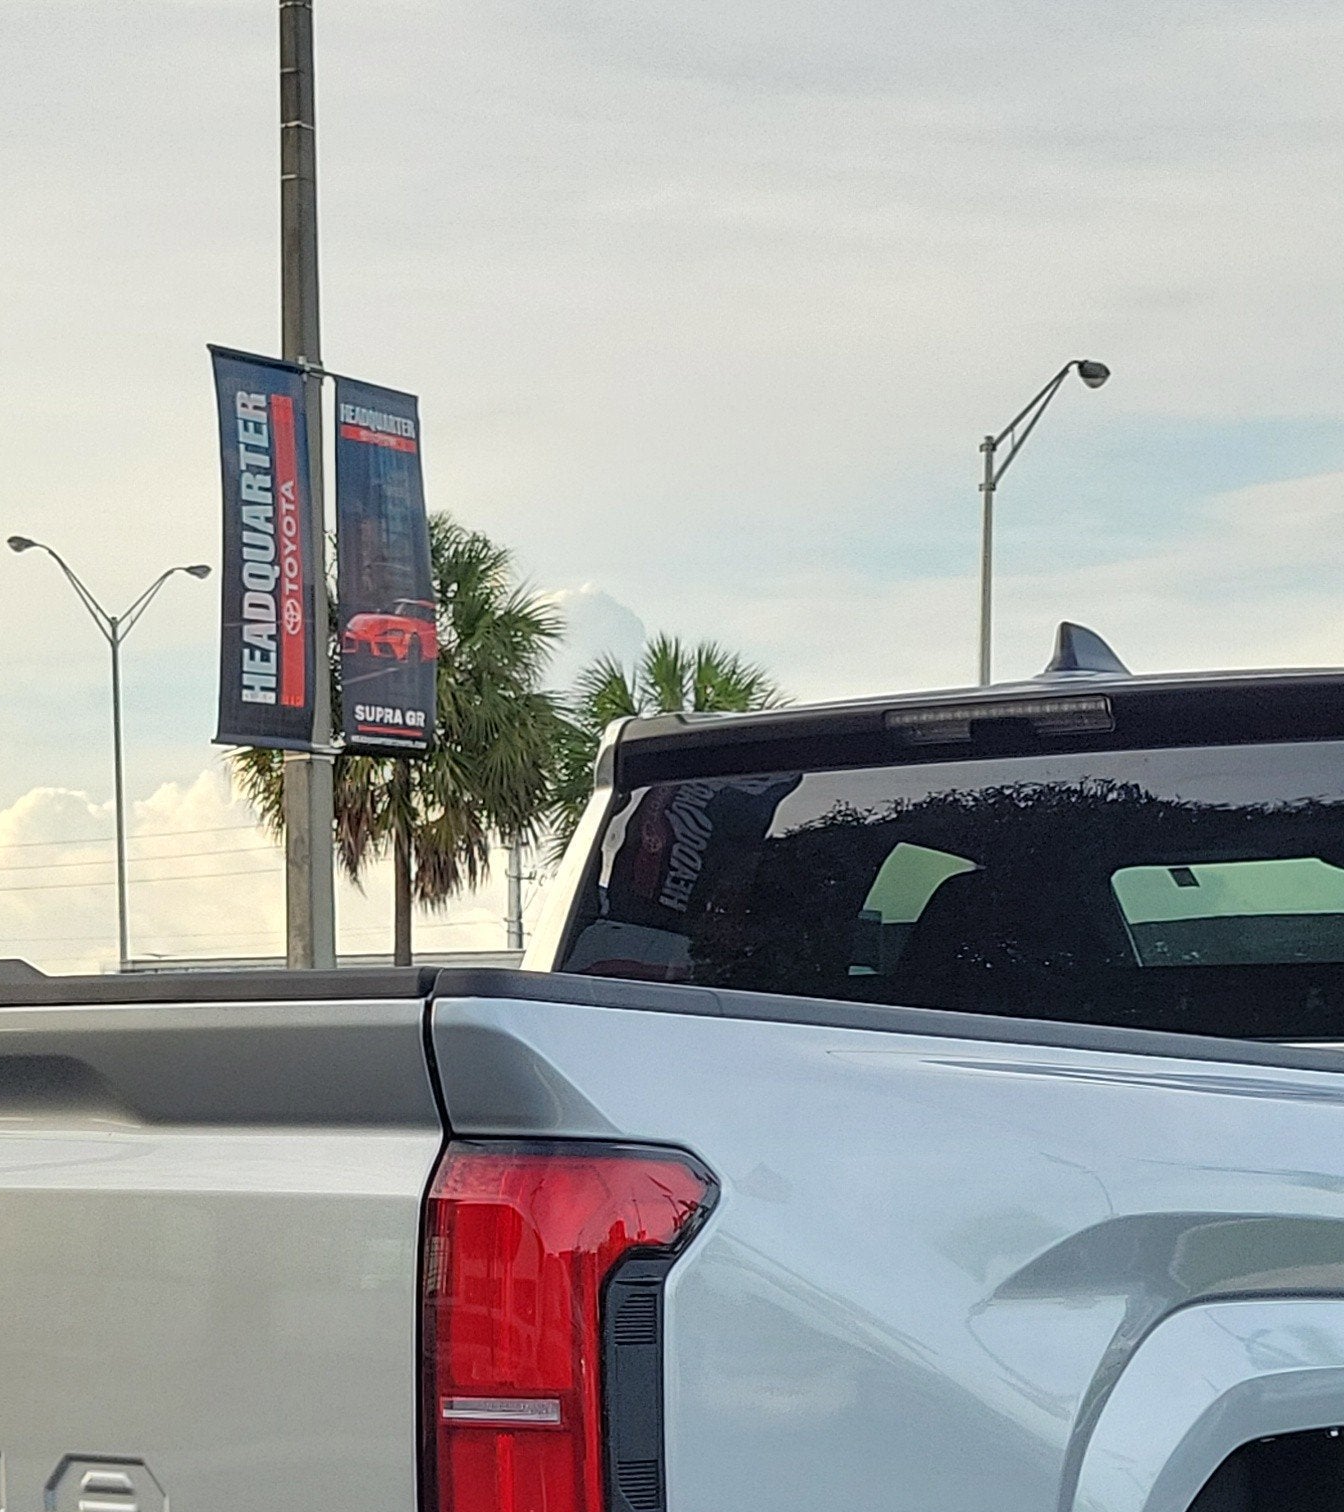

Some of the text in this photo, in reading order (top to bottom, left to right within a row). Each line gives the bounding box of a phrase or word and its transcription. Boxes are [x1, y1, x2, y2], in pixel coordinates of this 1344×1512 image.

[236, 390, 277, 705] HEADQUARTER
[281, 480, 301, 597] TOYOTA
[354, 704, 426, 728] SUPRA GR
